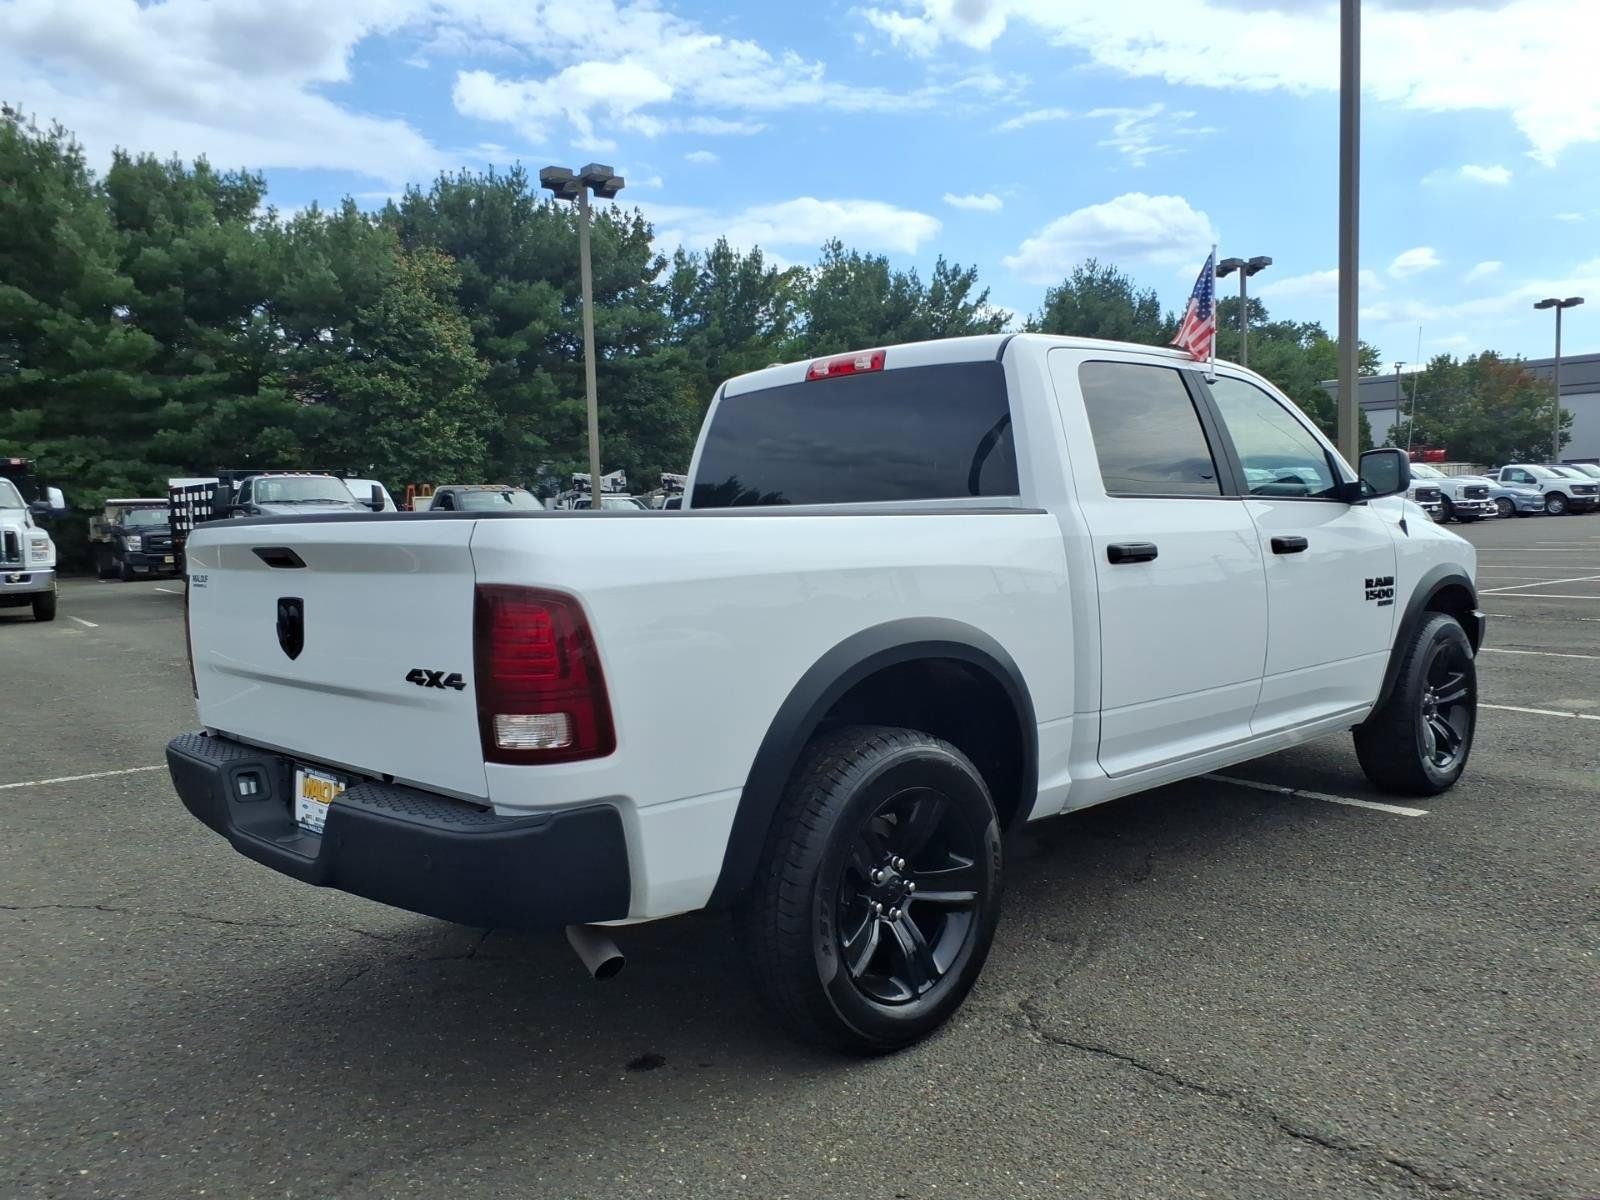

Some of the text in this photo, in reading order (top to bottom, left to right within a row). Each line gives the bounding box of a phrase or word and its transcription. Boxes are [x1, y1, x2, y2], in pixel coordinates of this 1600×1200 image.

[1365, 576, 1394, 589] RAM
[1365, 587, 1394, 601] 1500
[405, 668, 467, 691] 4X4
